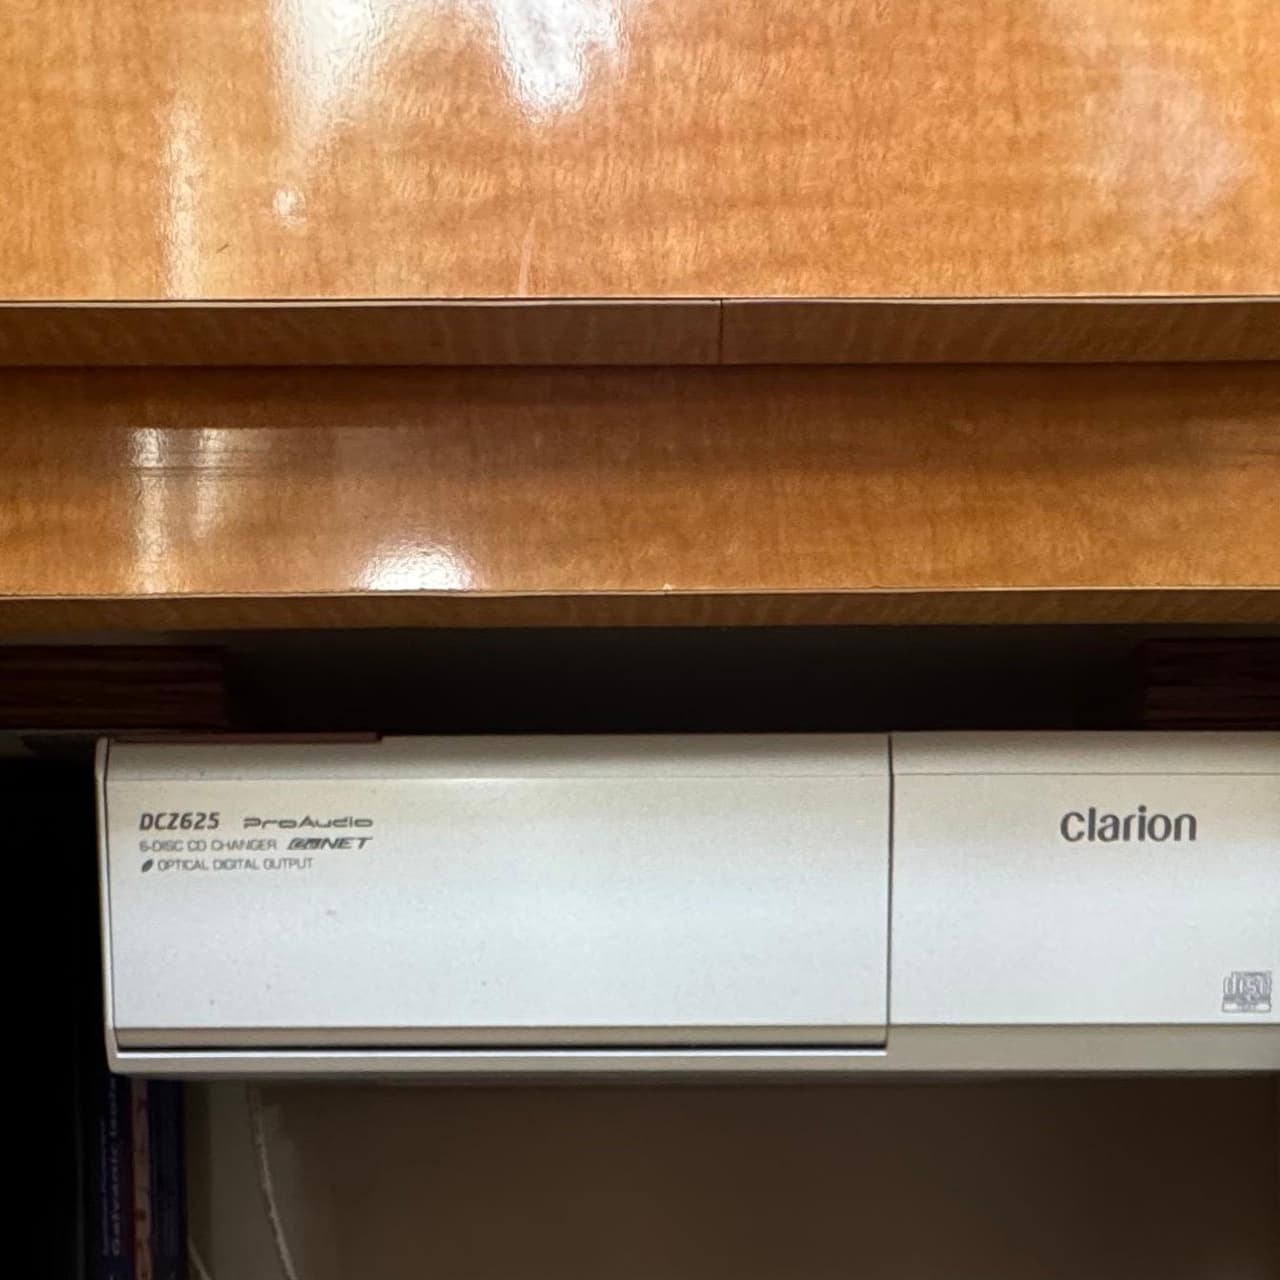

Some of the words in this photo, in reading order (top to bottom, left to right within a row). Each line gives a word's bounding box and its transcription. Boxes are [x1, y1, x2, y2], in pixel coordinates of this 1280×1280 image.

[139, 812, 221, 831] DCZ625
[243, 816, 375, 829] ProAudio
[139, 839, 185, 853] 6-DISC
[187, 840, 207, 852] CD
[211, 839, 278, 852] CHANGER
[157, 858, 210, 871] OPTICAL
[212, 858, 261, 871] DIGITAL
[263, 857, 315, 870] OUTPUT
